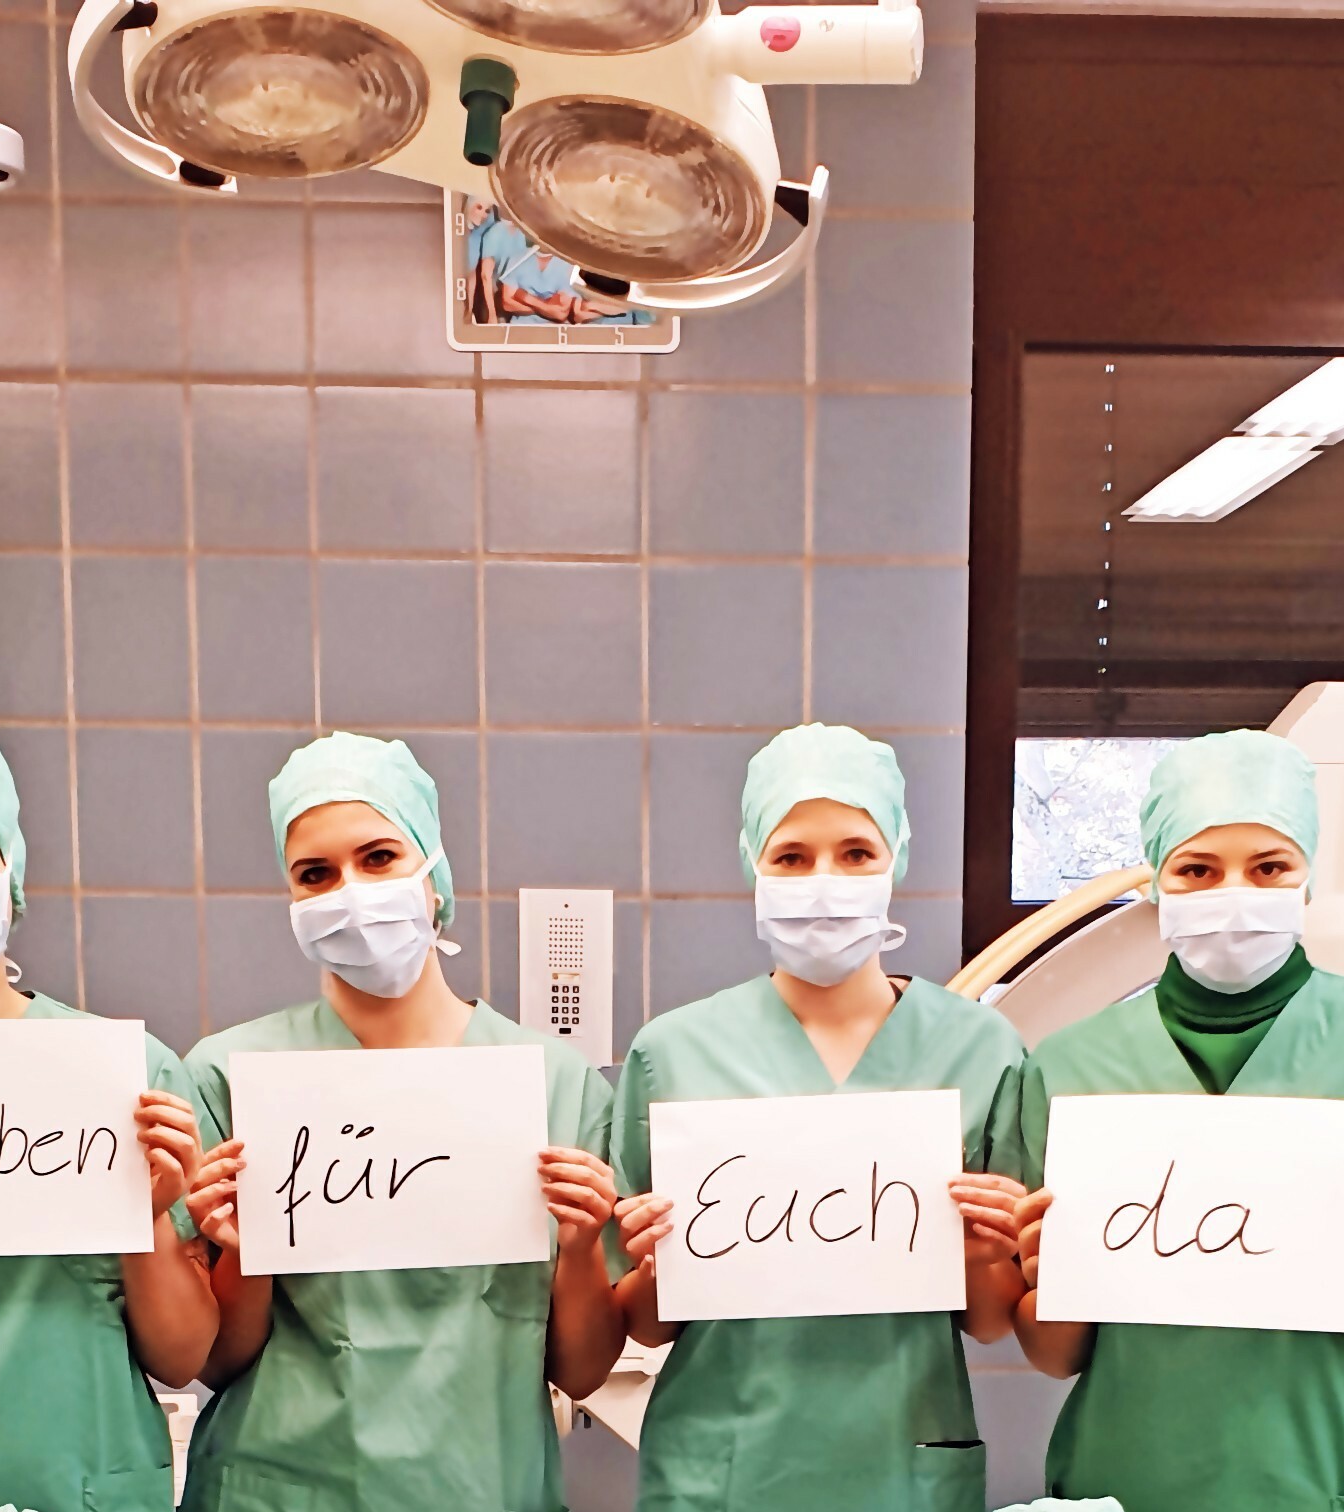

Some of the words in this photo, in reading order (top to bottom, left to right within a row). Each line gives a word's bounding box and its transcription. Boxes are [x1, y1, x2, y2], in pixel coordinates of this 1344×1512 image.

[456, 212, 465, 236] 9
[456, 277, 467, 301] 8
[558, 325, 568, 346] 6
[614, 325, 625, 346] 5
[275, 1123, 451, 1248] für
[685, 1155, 920, 1259] Euch
[1103, 1163, 1273, 1258] da
